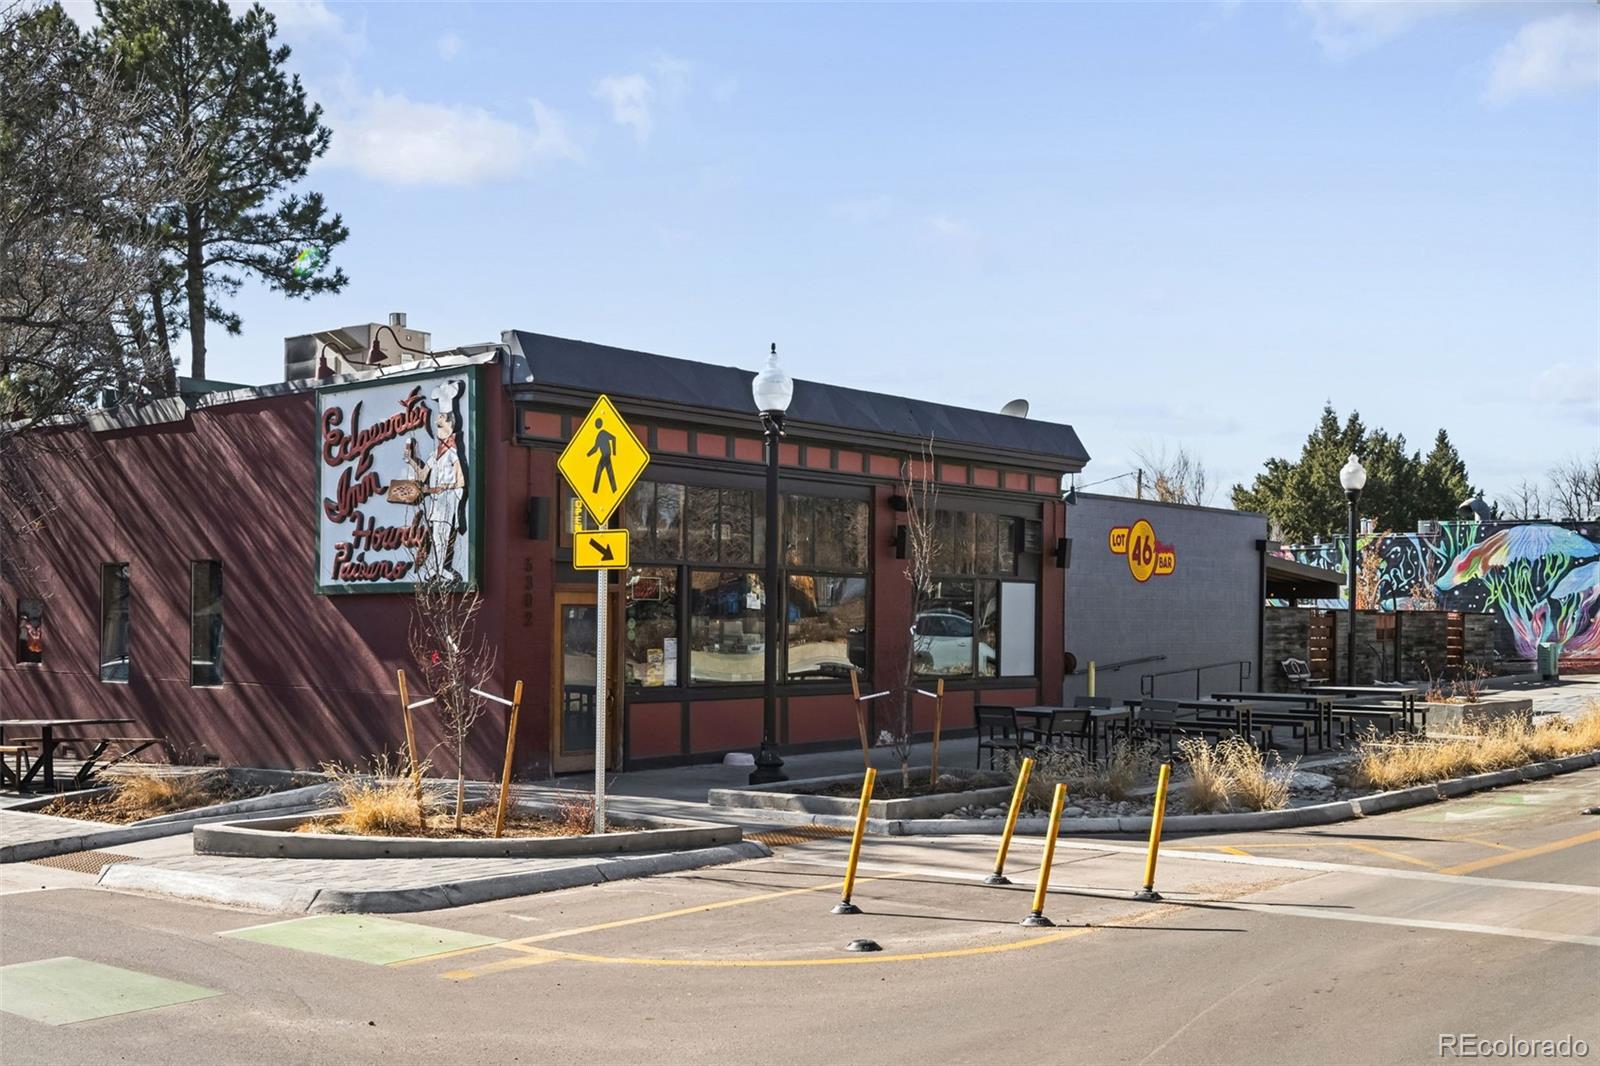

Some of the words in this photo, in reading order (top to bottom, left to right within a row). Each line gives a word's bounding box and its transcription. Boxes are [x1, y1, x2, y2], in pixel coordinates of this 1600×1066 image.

[323, 385, 434, 480] Edgewater
[324, 466, 389, 523] Inn
[331, 541, 414, 582] Paisano
[350, 509, 430, 573] Howdy
[1112, 534, 1126, 547] LOT
[1132, 535, 1152, 566] 46
[1159, 556, 1172, 569] BAR
